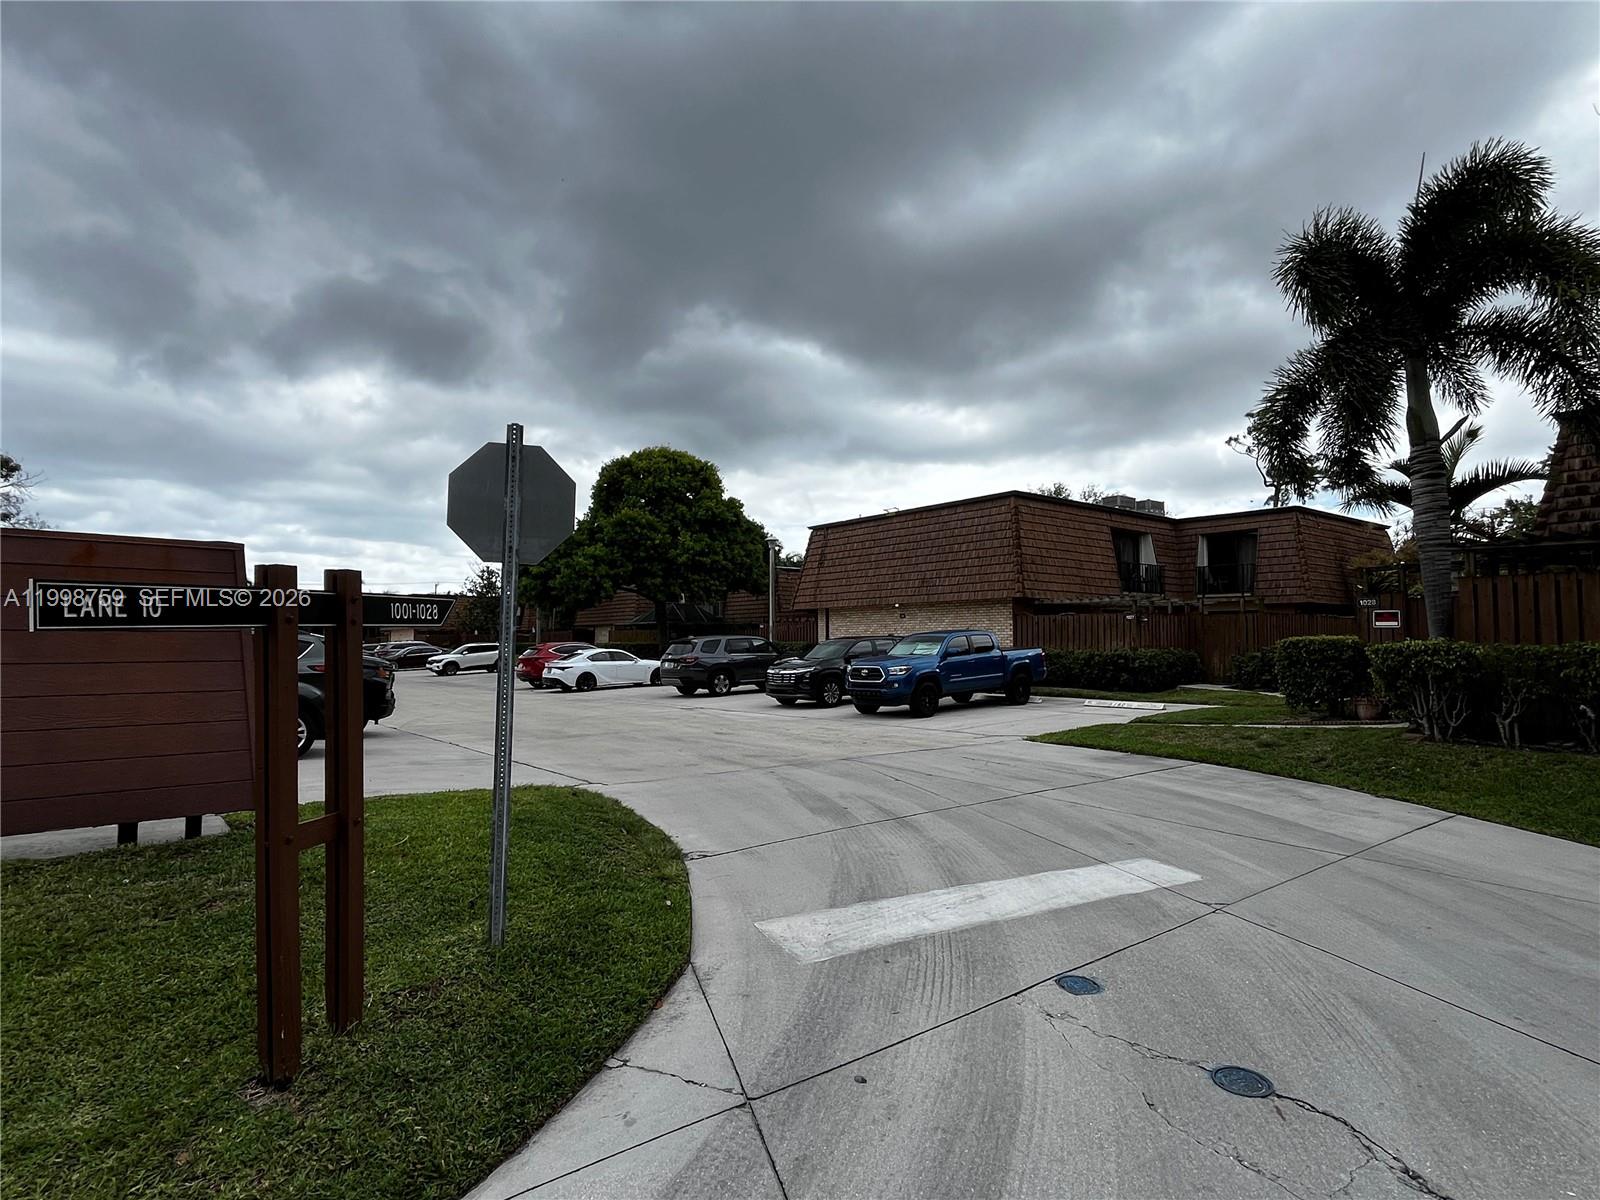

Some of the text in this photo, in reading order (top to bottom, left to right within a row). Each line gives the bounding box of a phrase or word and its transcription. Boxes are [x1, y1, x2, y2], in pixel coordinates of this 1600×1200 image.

[63, 594, 162, 618] LANE 10
[390, 602, 438, 620] 1001-1028
